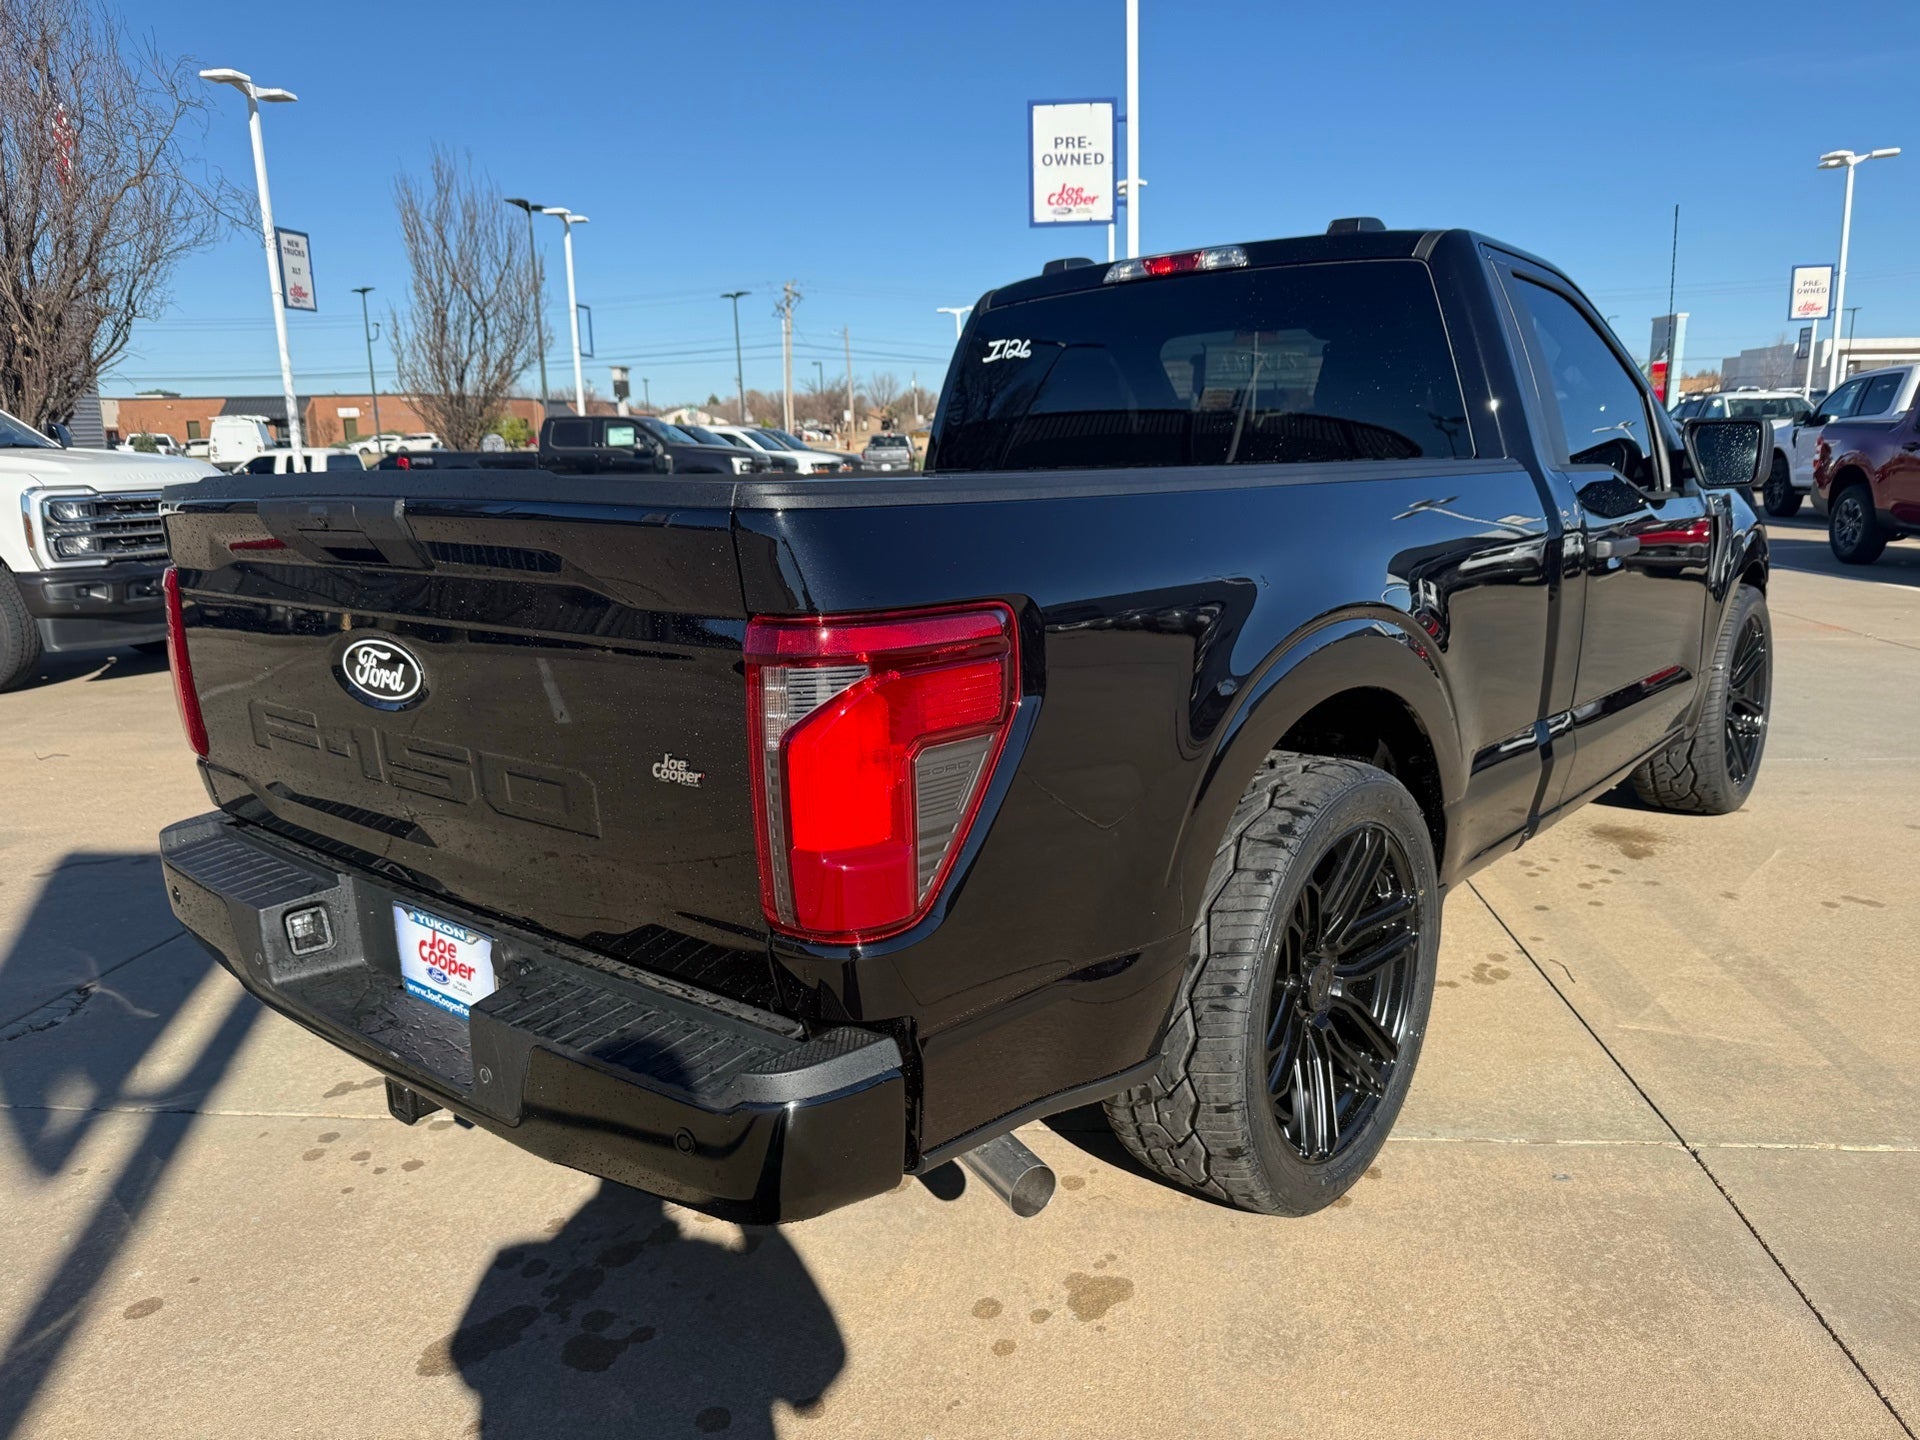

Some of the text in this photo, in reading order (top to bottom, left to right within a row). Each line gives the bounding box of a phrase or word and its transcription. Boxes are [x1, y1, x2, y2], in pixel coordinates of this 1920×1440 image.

[1054, 136, 1092, 149] PRE-
[1042, 153, 1104, 166] OWNED
[1058, 183, 1084, 197] Joe
[1047, 192, 1099, 207] Cooper
[286, 239, 300, 248] NEW
[283, 247, 305, 257] TRUCKS
[355, 646, 405, 692] Ford
[249, 699, 601, 840] F-150
[661, 753, 687, 770] Joe
[919, 760, 972, 776] FORD
[652, 762, 702, 783] Cooper
[416, 914, 466, 940] YUKON
[429, 930, 457, 957] Joe
[419, 940, 476, 981] Cooper
